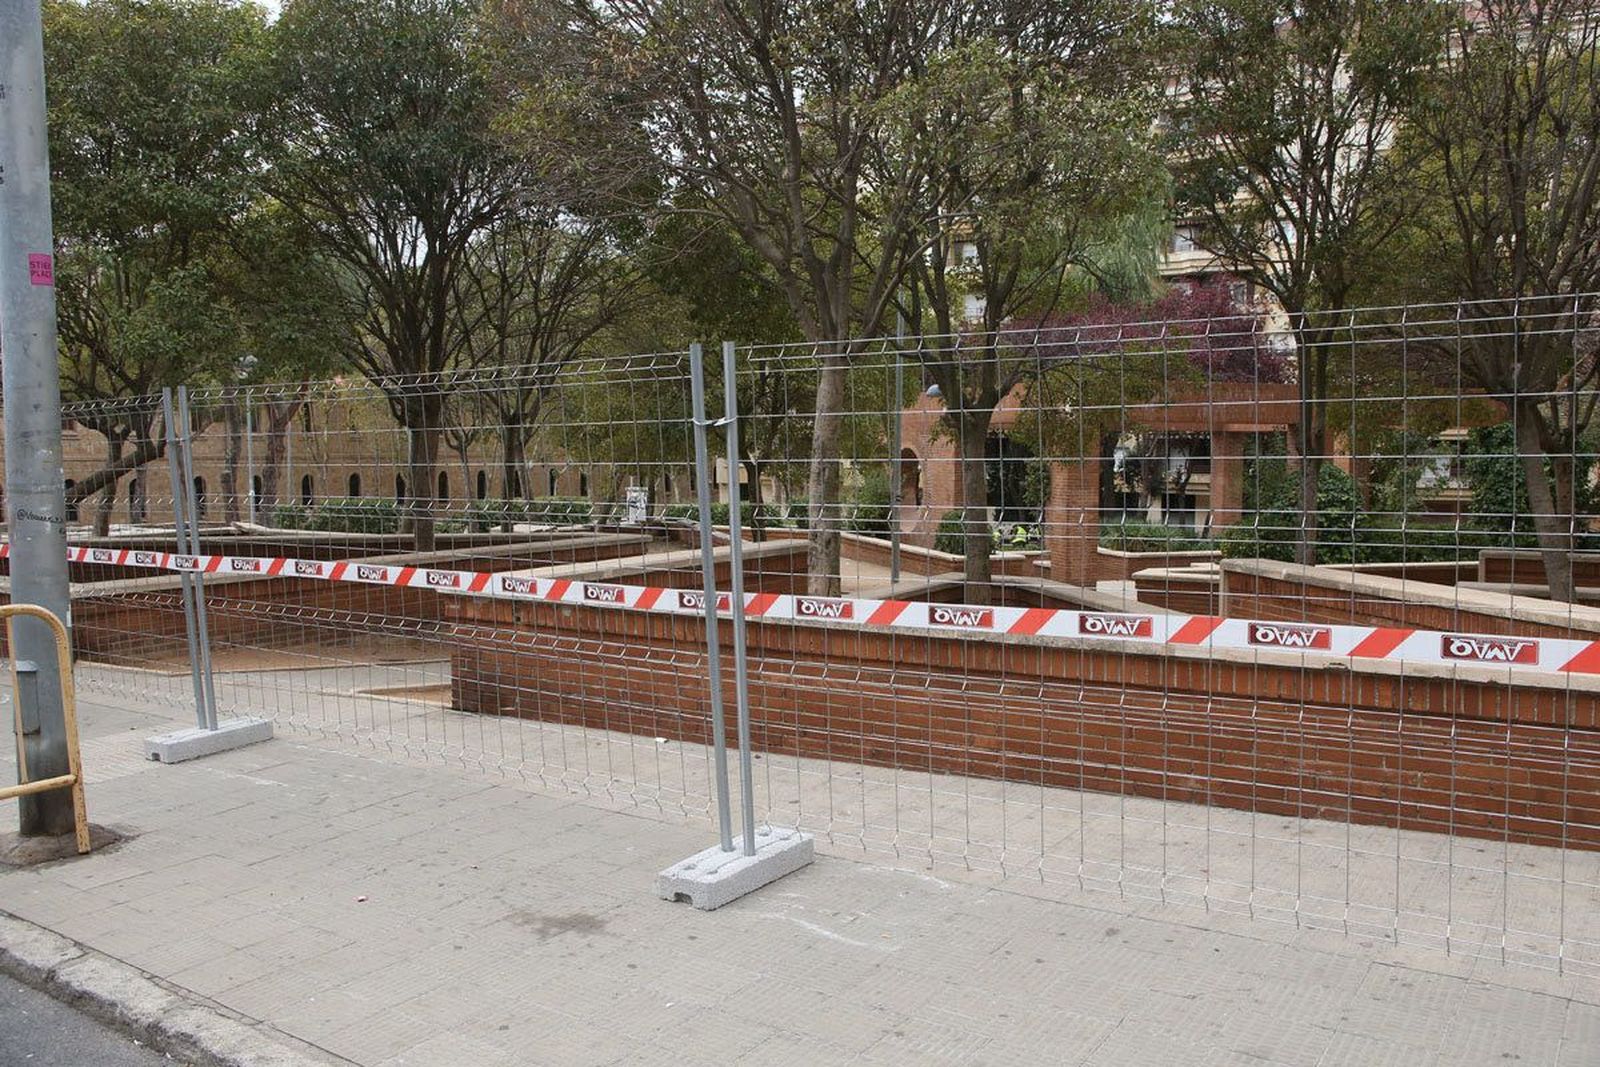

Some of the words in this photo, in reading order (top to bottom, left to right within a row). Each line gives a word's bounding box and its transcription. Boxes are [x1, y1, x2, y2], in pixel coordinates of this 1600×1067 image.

[801, 600, 851, 619] AMAQ
[933, 607, 990, 626] AMAQ
[1085, 616, 1149, 636] AMAQ
[1255, 625, 1327, 647] AMAQ
[1449, 638, 1534, 662] AMAQ
